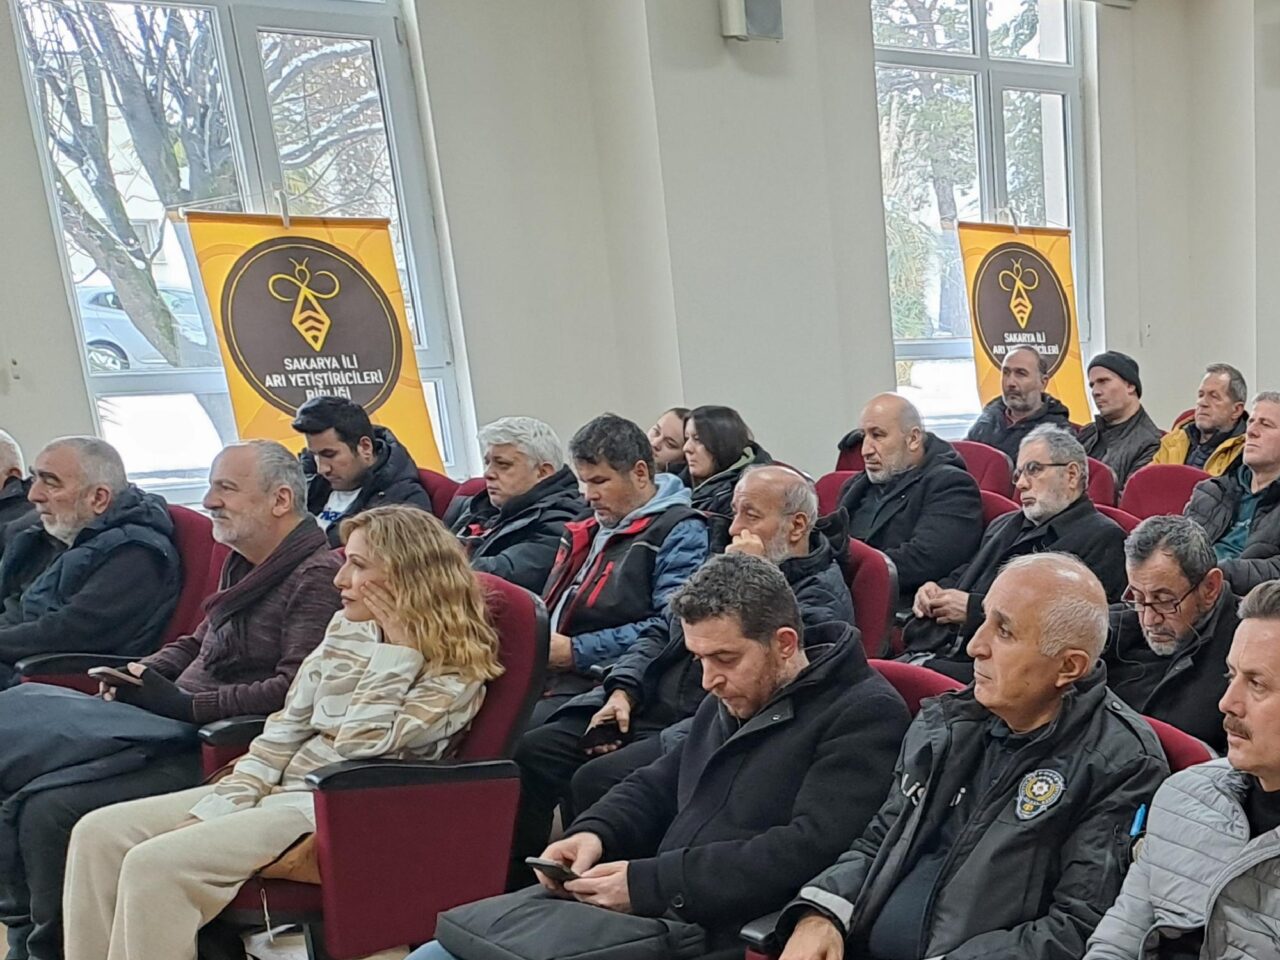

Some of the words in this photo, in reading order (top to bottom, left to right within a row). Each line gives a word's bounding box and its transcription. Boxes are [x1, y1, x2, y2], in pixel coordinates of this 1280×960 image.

[1004, 333, 1035, 343] SAKARYA
[1036, 332, 1046, 343] İLİ
[993, 345, 1005, 355] ARI
[283, 356, 340, 370] SAKARYA
[341, 353, 359, 369] İLİ
[265, 374, 287, 388] ARI
[288, 369, 384, 389] YETİŞTİRİCİLERİ
